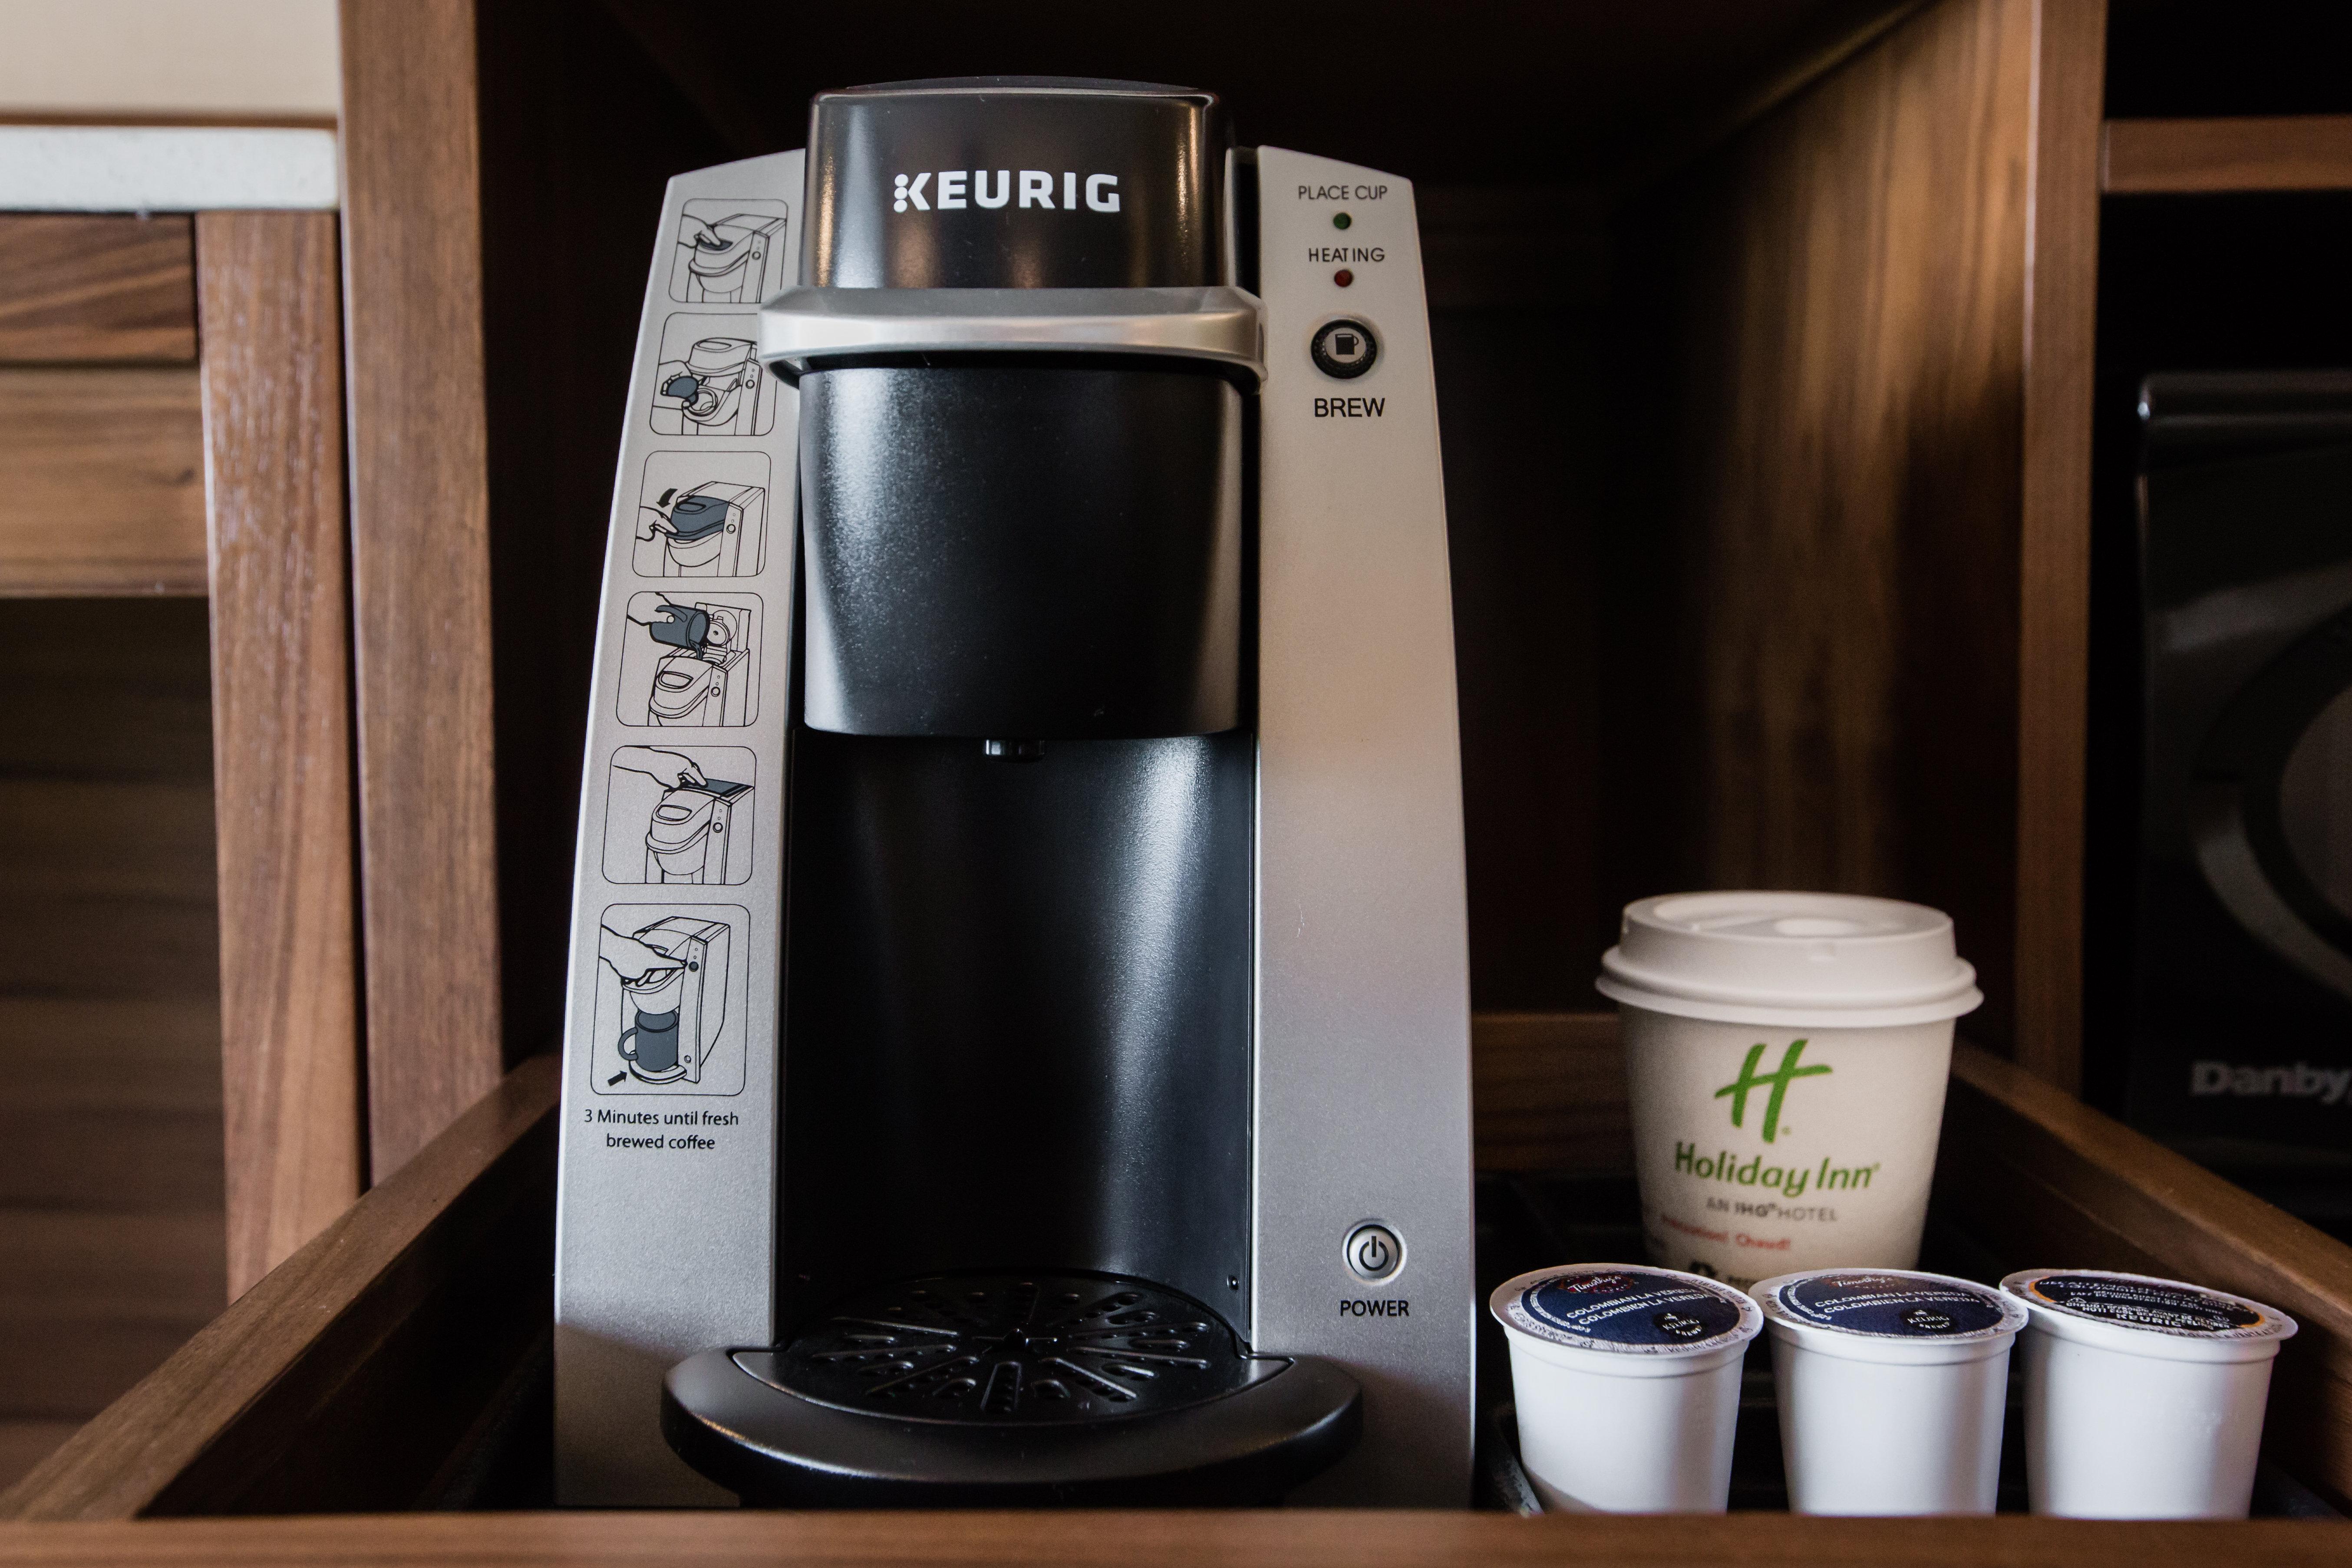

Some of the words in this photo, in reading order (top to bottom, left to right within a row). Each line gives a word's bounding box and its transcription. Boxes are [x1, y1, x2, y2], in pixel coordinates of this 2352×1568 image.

[894, 170, 1120, 213] KEURIG
[1298, 185, 1349, 200] PLACE
[1355, 185, 1387, 200] CUP
[1309, 248, 1385, 262] HEATING
[1314, 398, 1385, 417] BREW
[2190, 1061, 2349, 1105] Danby
[584, 1109, 592, 1122] 3
[597, 1109, 659, 1124] Minutes
[664, 1110, 698, 1125] until
[703, 1111, 739, 1126] fresh
[607, 1133, 664, 1149] brewed
[669, 1135, 715, 1149] coffee
[1674, 1141, 1810, 1198] Holiday
[1706, 1196, 1729, 1212] AN
[1778, 1205, 1837, 1221] HOTEL
[1340, 1300, 1409, 1316] POWER
[1567, 1296, 1638, 1319] COLOMBIAN
[1815, 1292, 1896, 1307] COLOMBIAN
[1824, 1298, 1905, 1313] COLOMBIEN
[1579, 1302, 1649, 1325] COLOMBIEN
[1664, 1293, 1710, 1303] VEREDA
[2116, 1313, 2182, 1327] KEURIG
